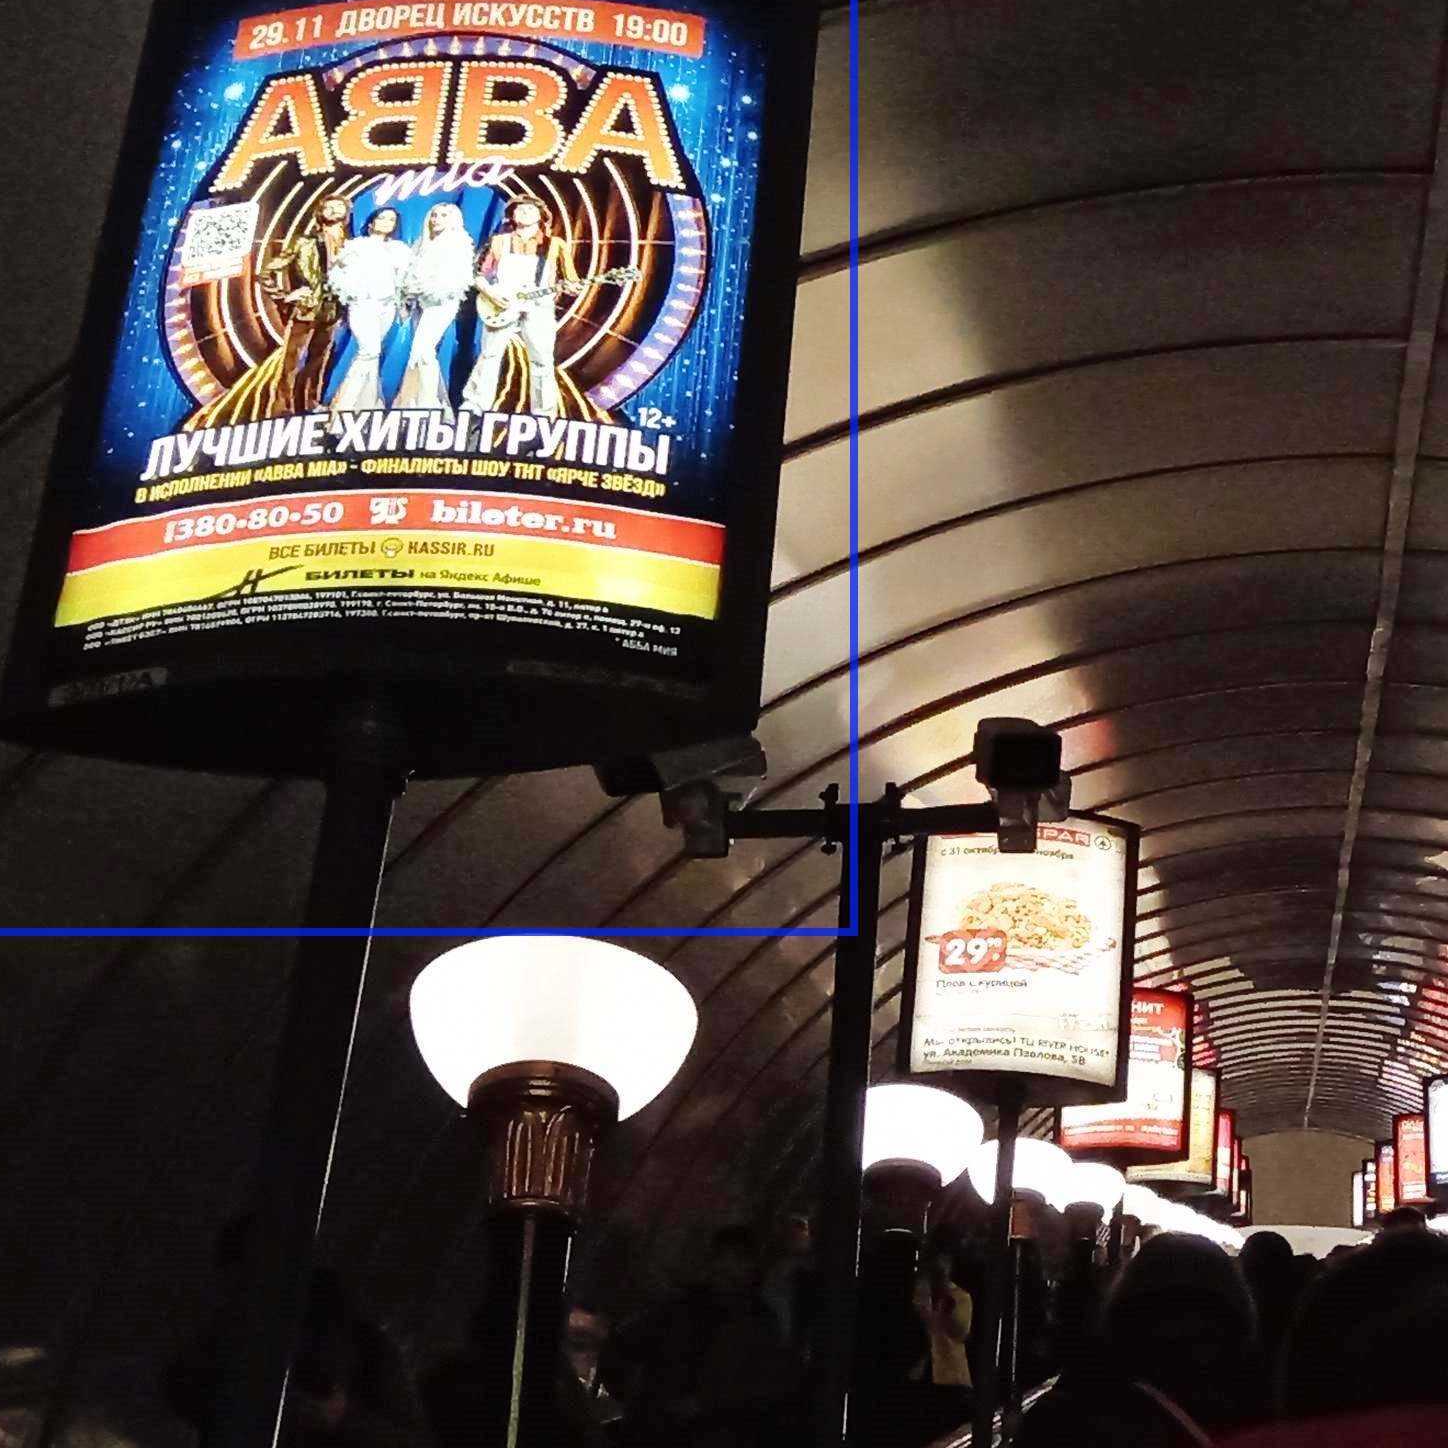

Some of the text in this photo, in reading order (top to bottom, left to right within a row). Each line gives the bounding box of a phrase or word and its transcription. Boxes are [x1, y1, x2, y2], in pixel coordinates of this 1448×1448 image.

[250, 1, 688, 50] 29.11 ДВОРЕЦ ИСКУССТВ 19:00
[638, 407, 676, 429] 12+
[140, 410, 670, 481] ЛУЧШИЕ ХИТЫ ГРУППЫ
[135, 487, 147, 503] В
[149, 469, 252, 501] ИСПОЛНЕНИИ
[361, 457, 468, 475] ФИНАЛИСТЫ
[471, 458, 510, 477] ШОУ
[513, 462, 545, 481] ТНТ
[547, 467, 598, 488] «ЯРЧЕ
[431, 500, 616, 539] bileter.ru
[269, 541, 376, 560] ВСЕ БИЛЕТЫ
[408, 541, 495, 557] KASSIR.RU
[305, 568, 414, 581] БИЛЕТЫ
[420, 571, 437, 579] на
[439, 569, 488, 582] Яндекс
